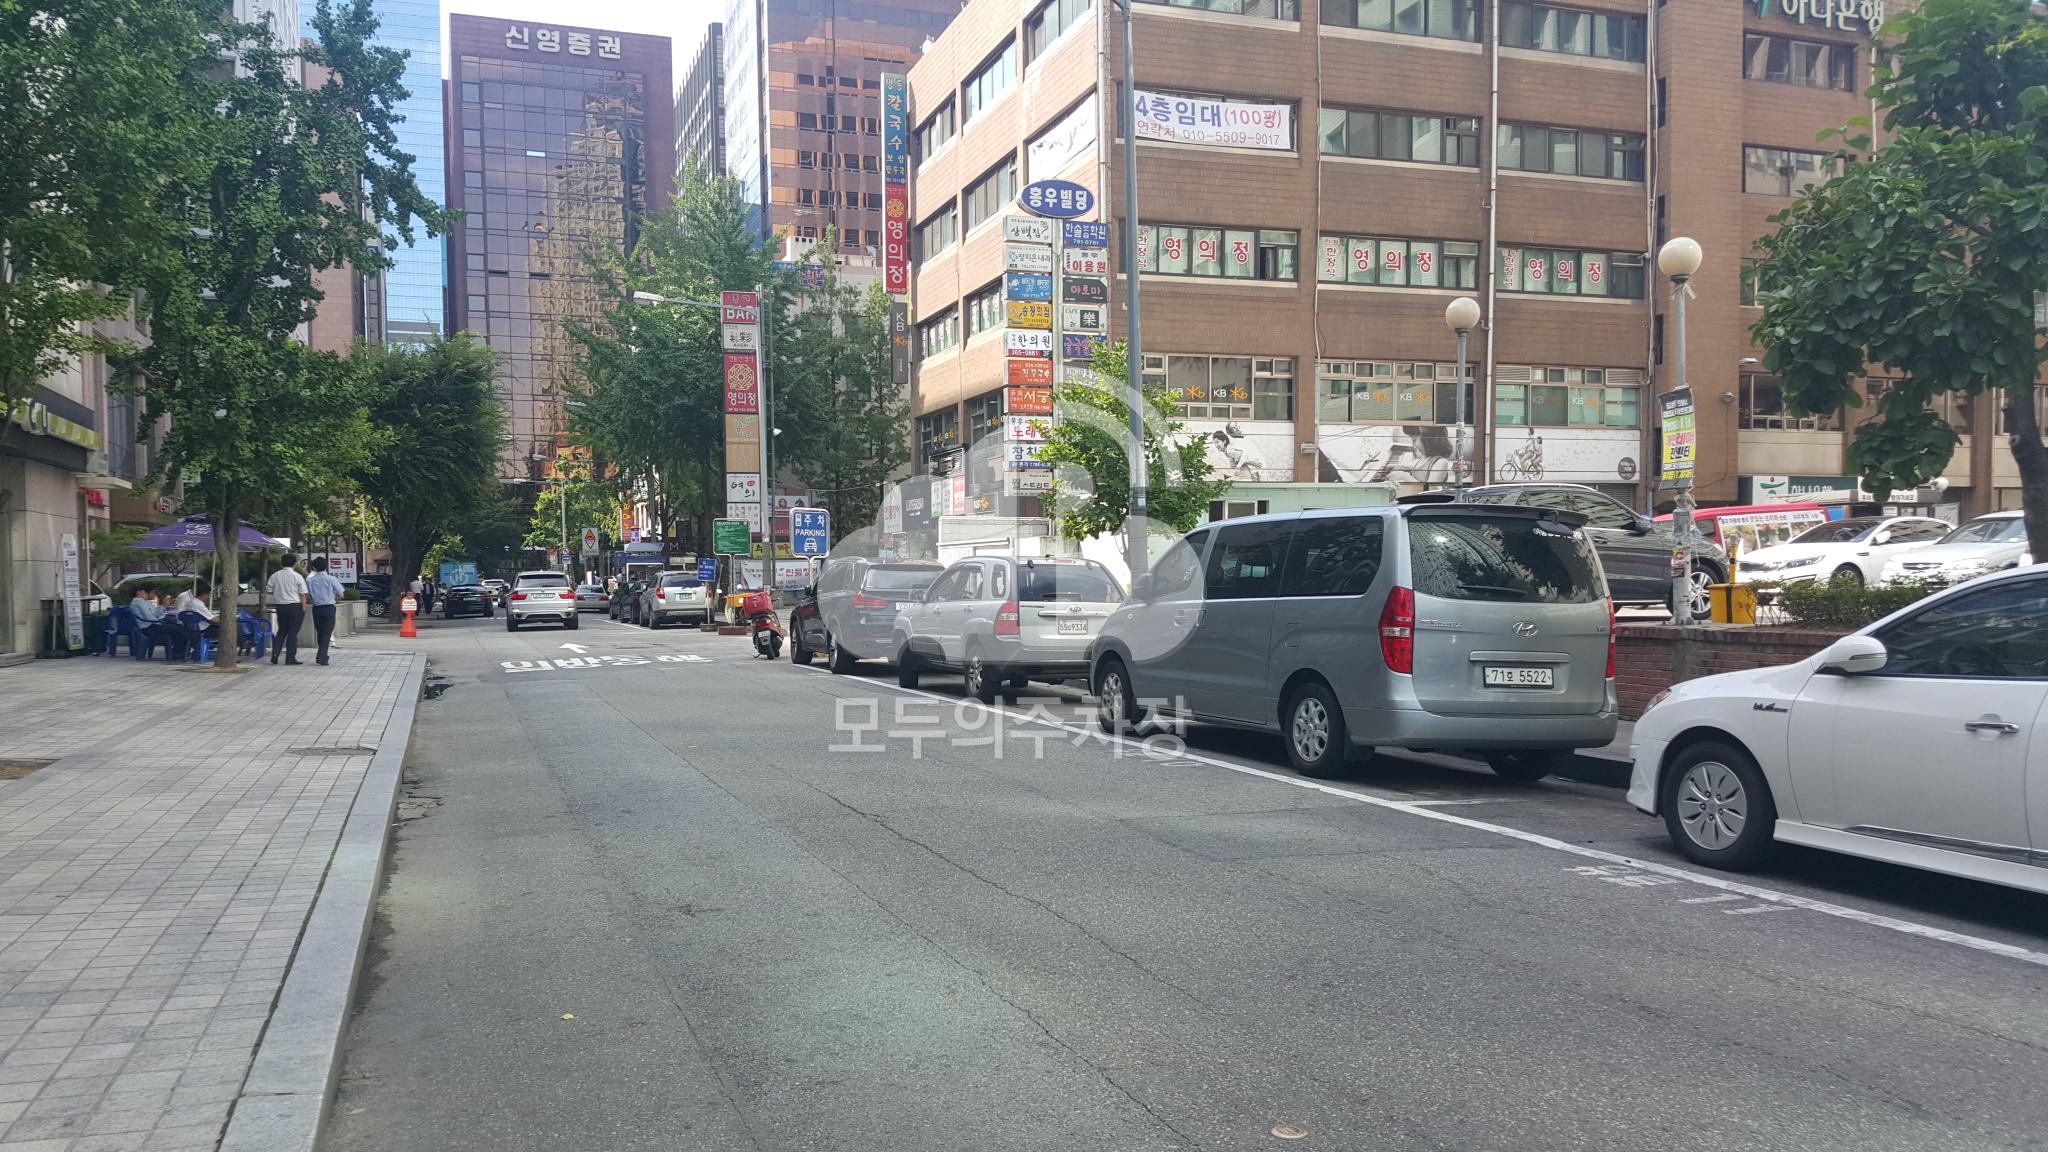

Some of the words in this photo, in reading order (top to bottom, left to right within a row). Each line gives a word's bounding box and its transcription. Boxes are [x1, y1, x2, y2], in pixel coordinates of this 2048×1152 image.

[505, 25, 621, 60] 신영증권
[1135, 95, 1222, 128] 4층임대
[1224, 107, 1282, 130] (100평)
[1137, 120, 1176, 139] 연락처
[1182, 128, 1281, 146] 010-5509-9017
[1029, 186, 1088, 211] 홍우빌딩
[887, 220, 904, 284] 영의정
[1163, 236, 1250, 264] 영의정
[1353, 247, 1434, 274] 영의정
[1072, 260, 1106, 273] 이용원
[1528, 258, 1602, 284] 영의정
[1082, 311, 1098, 327] 樂
[1018, 333, 1051, 349] 한의원
[727, 391, 756, 407] 영의정
[1023, 390, 1051, 404] 서궁
[794, 528, 826, 538] PARKING
[1519, 670, 1547, 684] 5522
